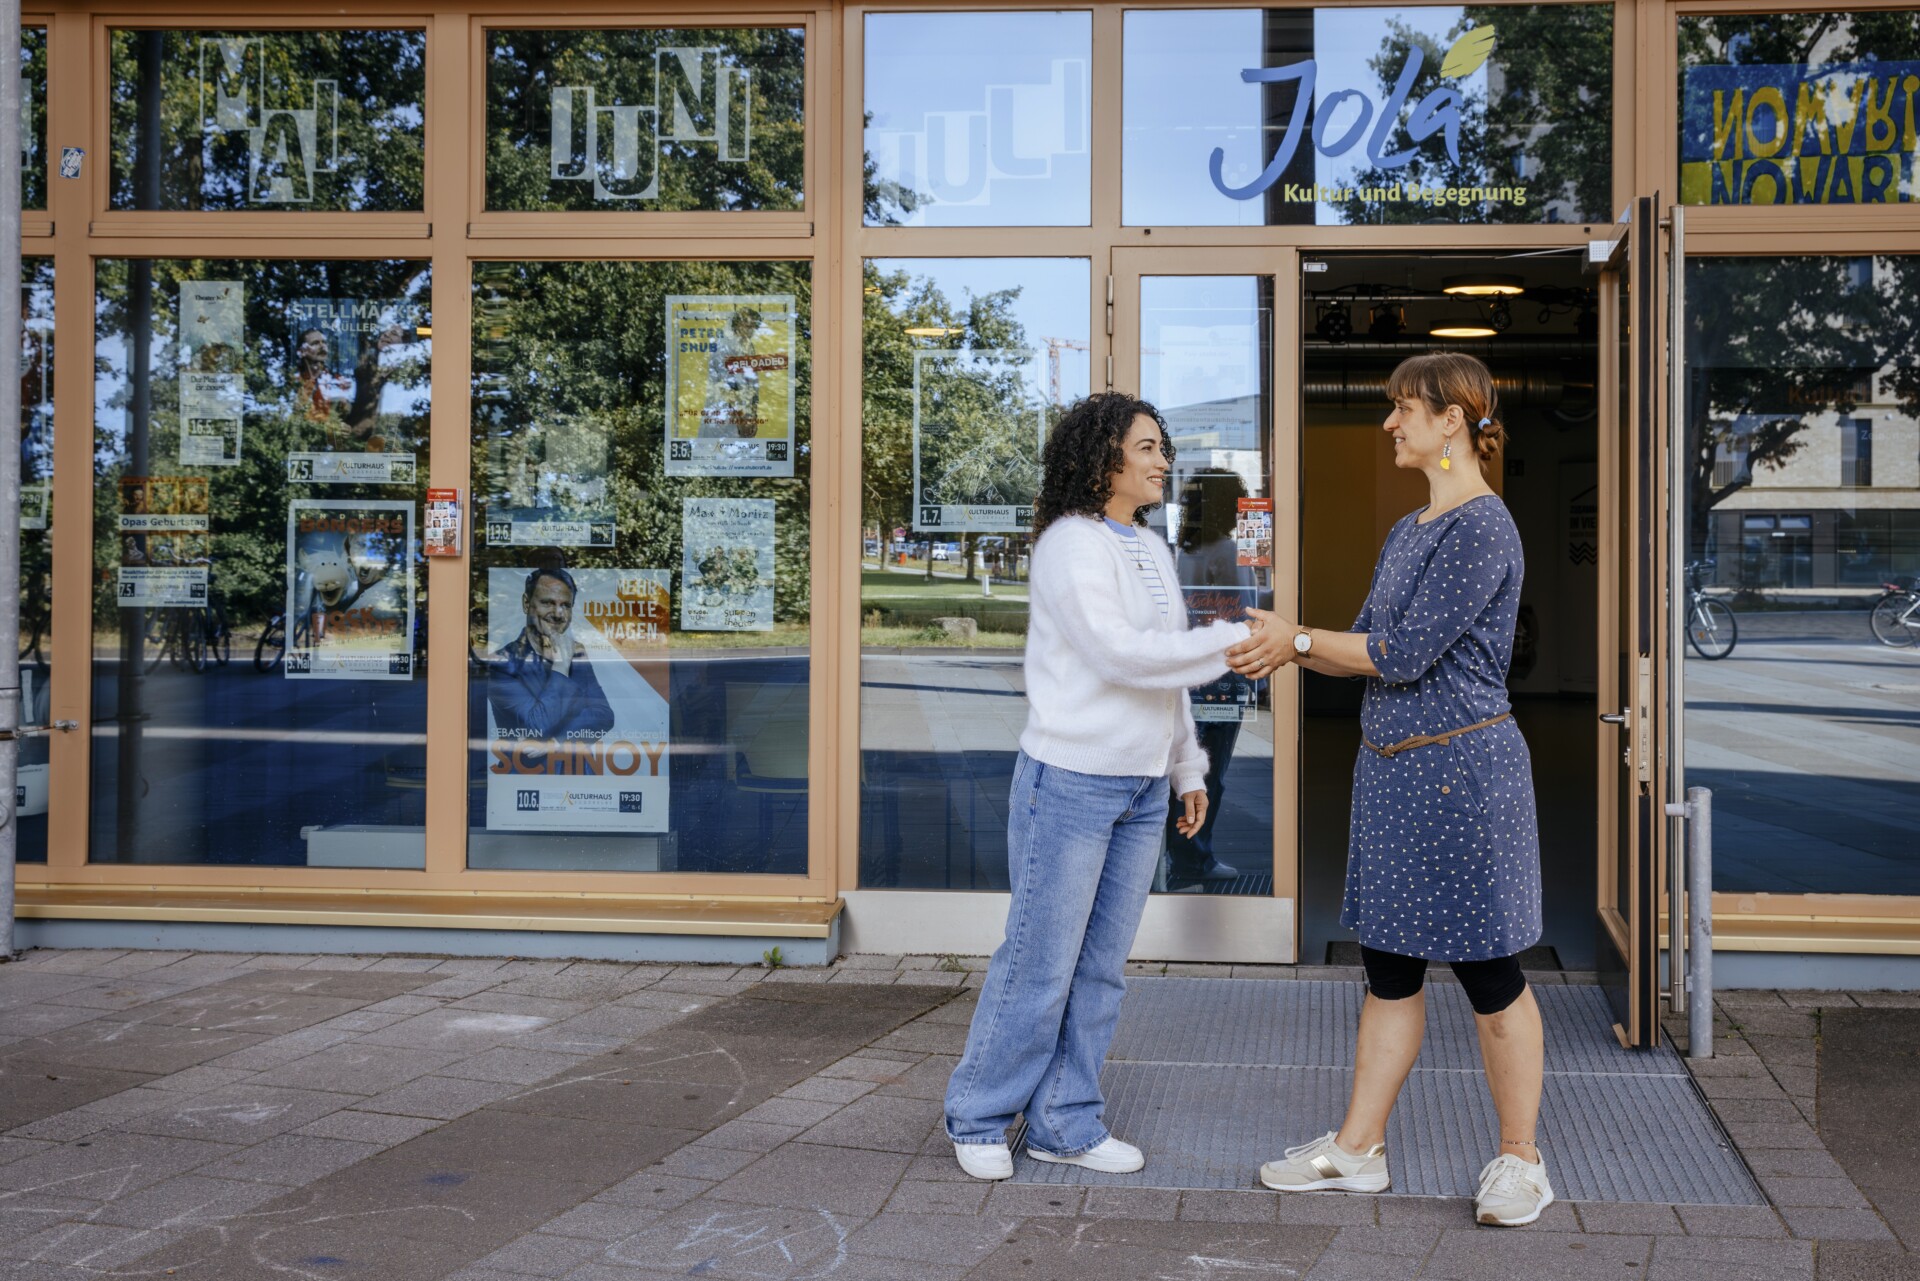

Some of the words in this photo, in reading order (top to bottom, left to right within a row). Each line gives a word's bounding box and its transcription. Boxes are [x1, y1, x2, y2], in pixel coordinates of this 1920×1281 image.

[1209, 44, 1464, 200] Jola
[1284, 183, 1352, 203] Kultur
[1359, 183, 1401, 202] und
[1407, 183, 1527, 206] Begegnung
[680, 328, 724, 338] PETER
[671, 443, 690, 458] 3.6.
[767, 443, 786, 451] 19:30
[290, 461, 312, 480] 7.5.
[729, 507, 769, 519] Moritz
[921, 509, 940, 523] 1.7.
[121, 518, 148, 527] Opas
[150, 518, 206, 528] Geburtstag
[490, 524, 511, 540] 13.6.
[616, 578, 657, 596] MEHR
[584, 600, 657, 618] IDIOTIE
[603, 622, 657, 641] WAGEN
[491, 728, 543, 738] SEBASTIAN
[566, 728, 619, 740] politisches
[489, 738, 668, 777] SCHNOY
[518, 792, 540, 808] 10.6.
[568, 793, 613, 801] KULTURHAUS
[620, 793, 641, 802] 19:30
